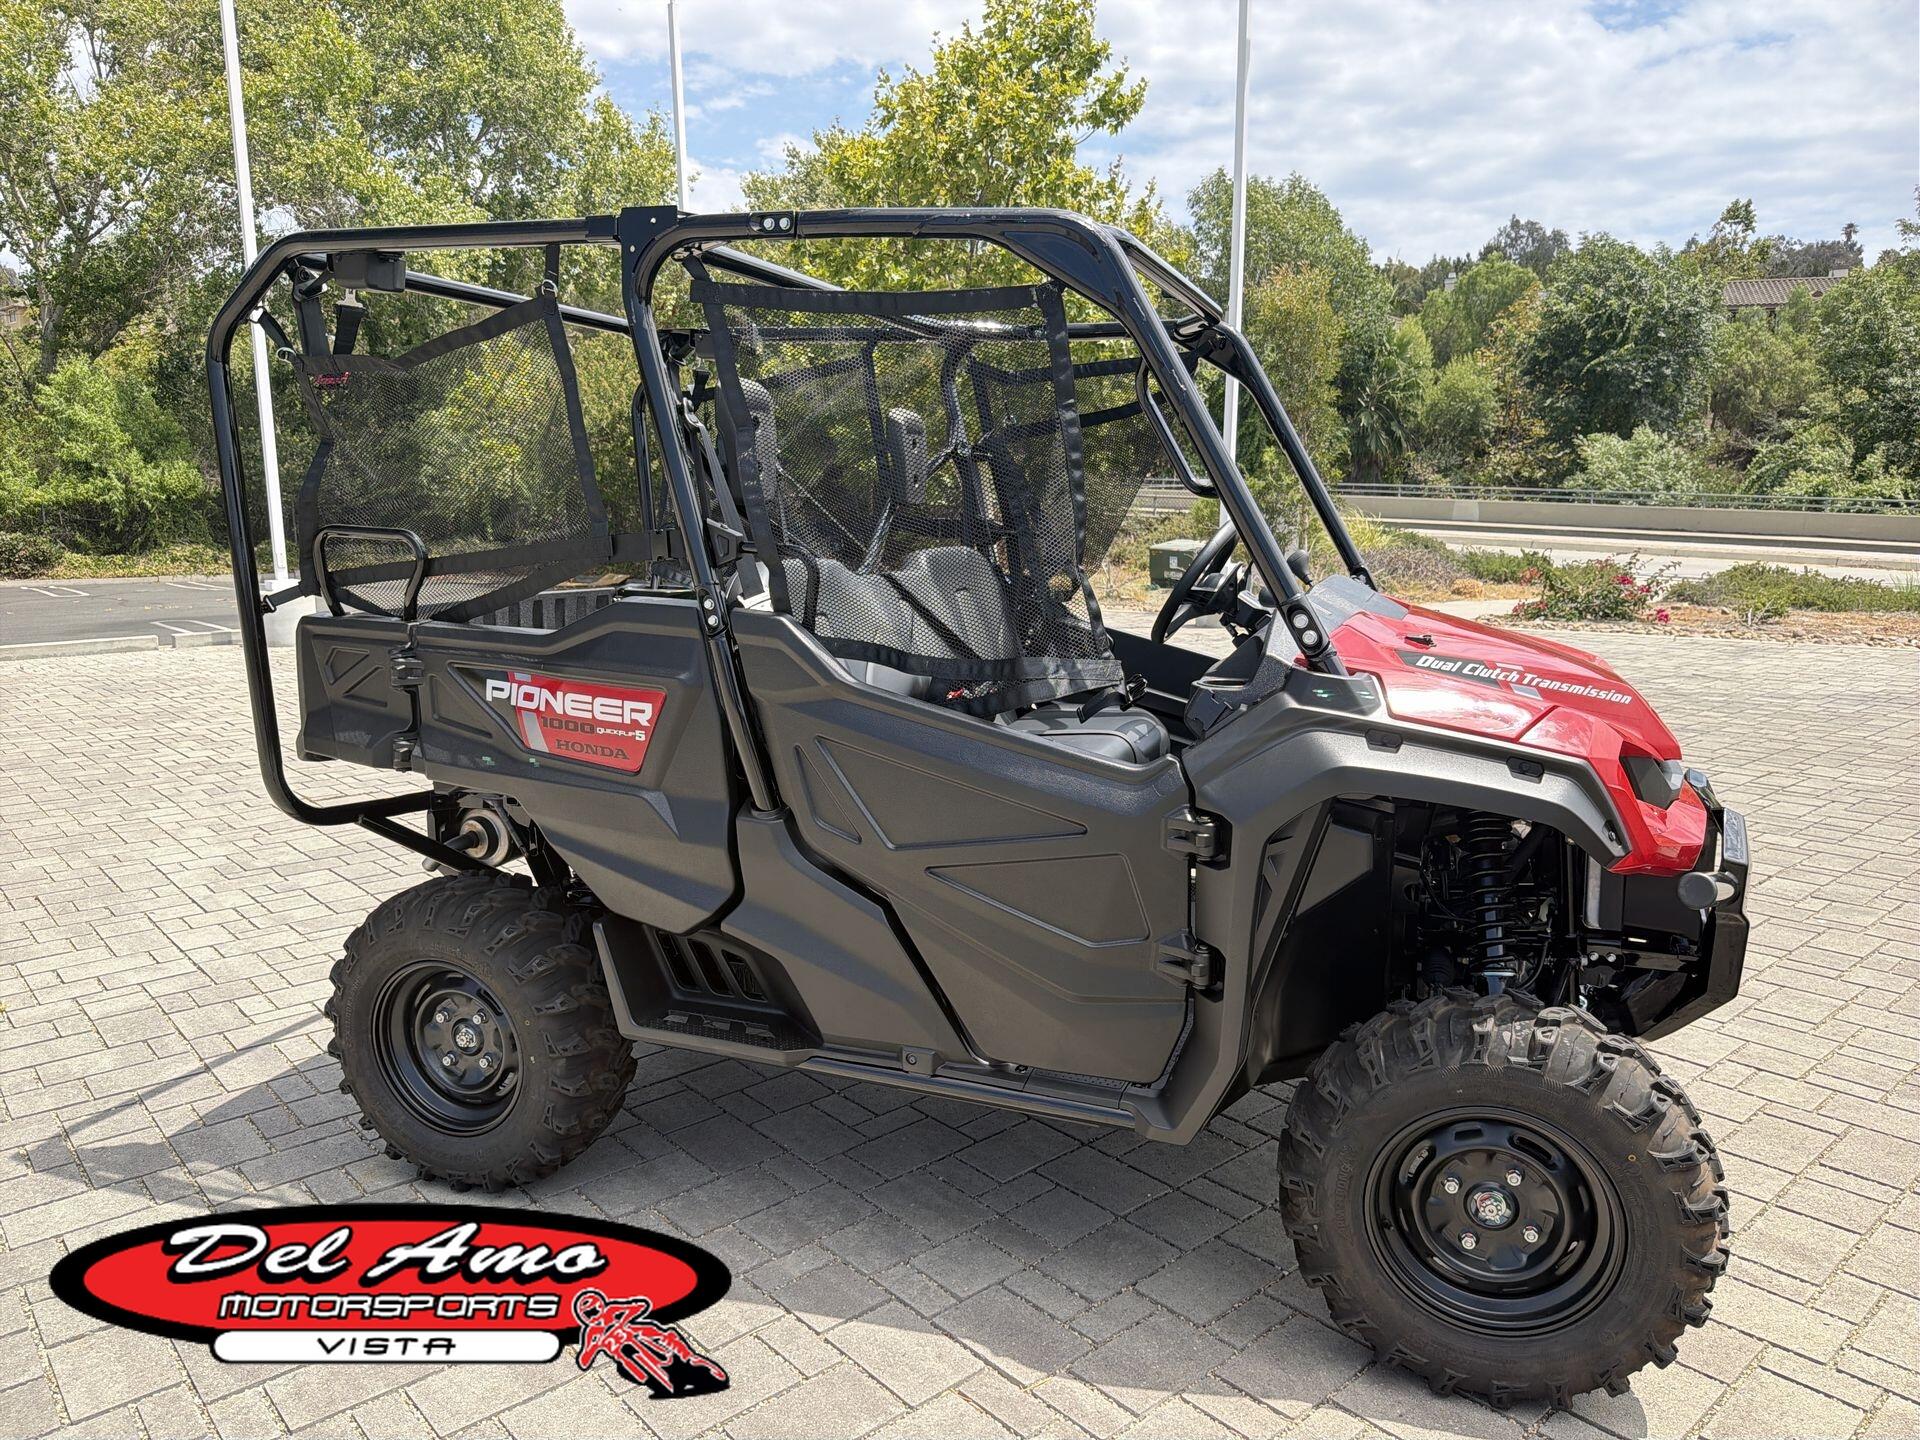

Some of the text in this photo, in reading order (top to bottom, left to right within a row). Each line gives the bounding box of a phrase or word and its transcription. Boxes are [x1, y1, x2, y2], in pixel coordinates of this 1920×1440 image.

[1415, 655, 1632, 705] Dual Clutch Transmission
[485, 678, 653, 727] PIONEER
[541, 716, 595, 734] 1000
[555, 739, 630, 760] HONDA
